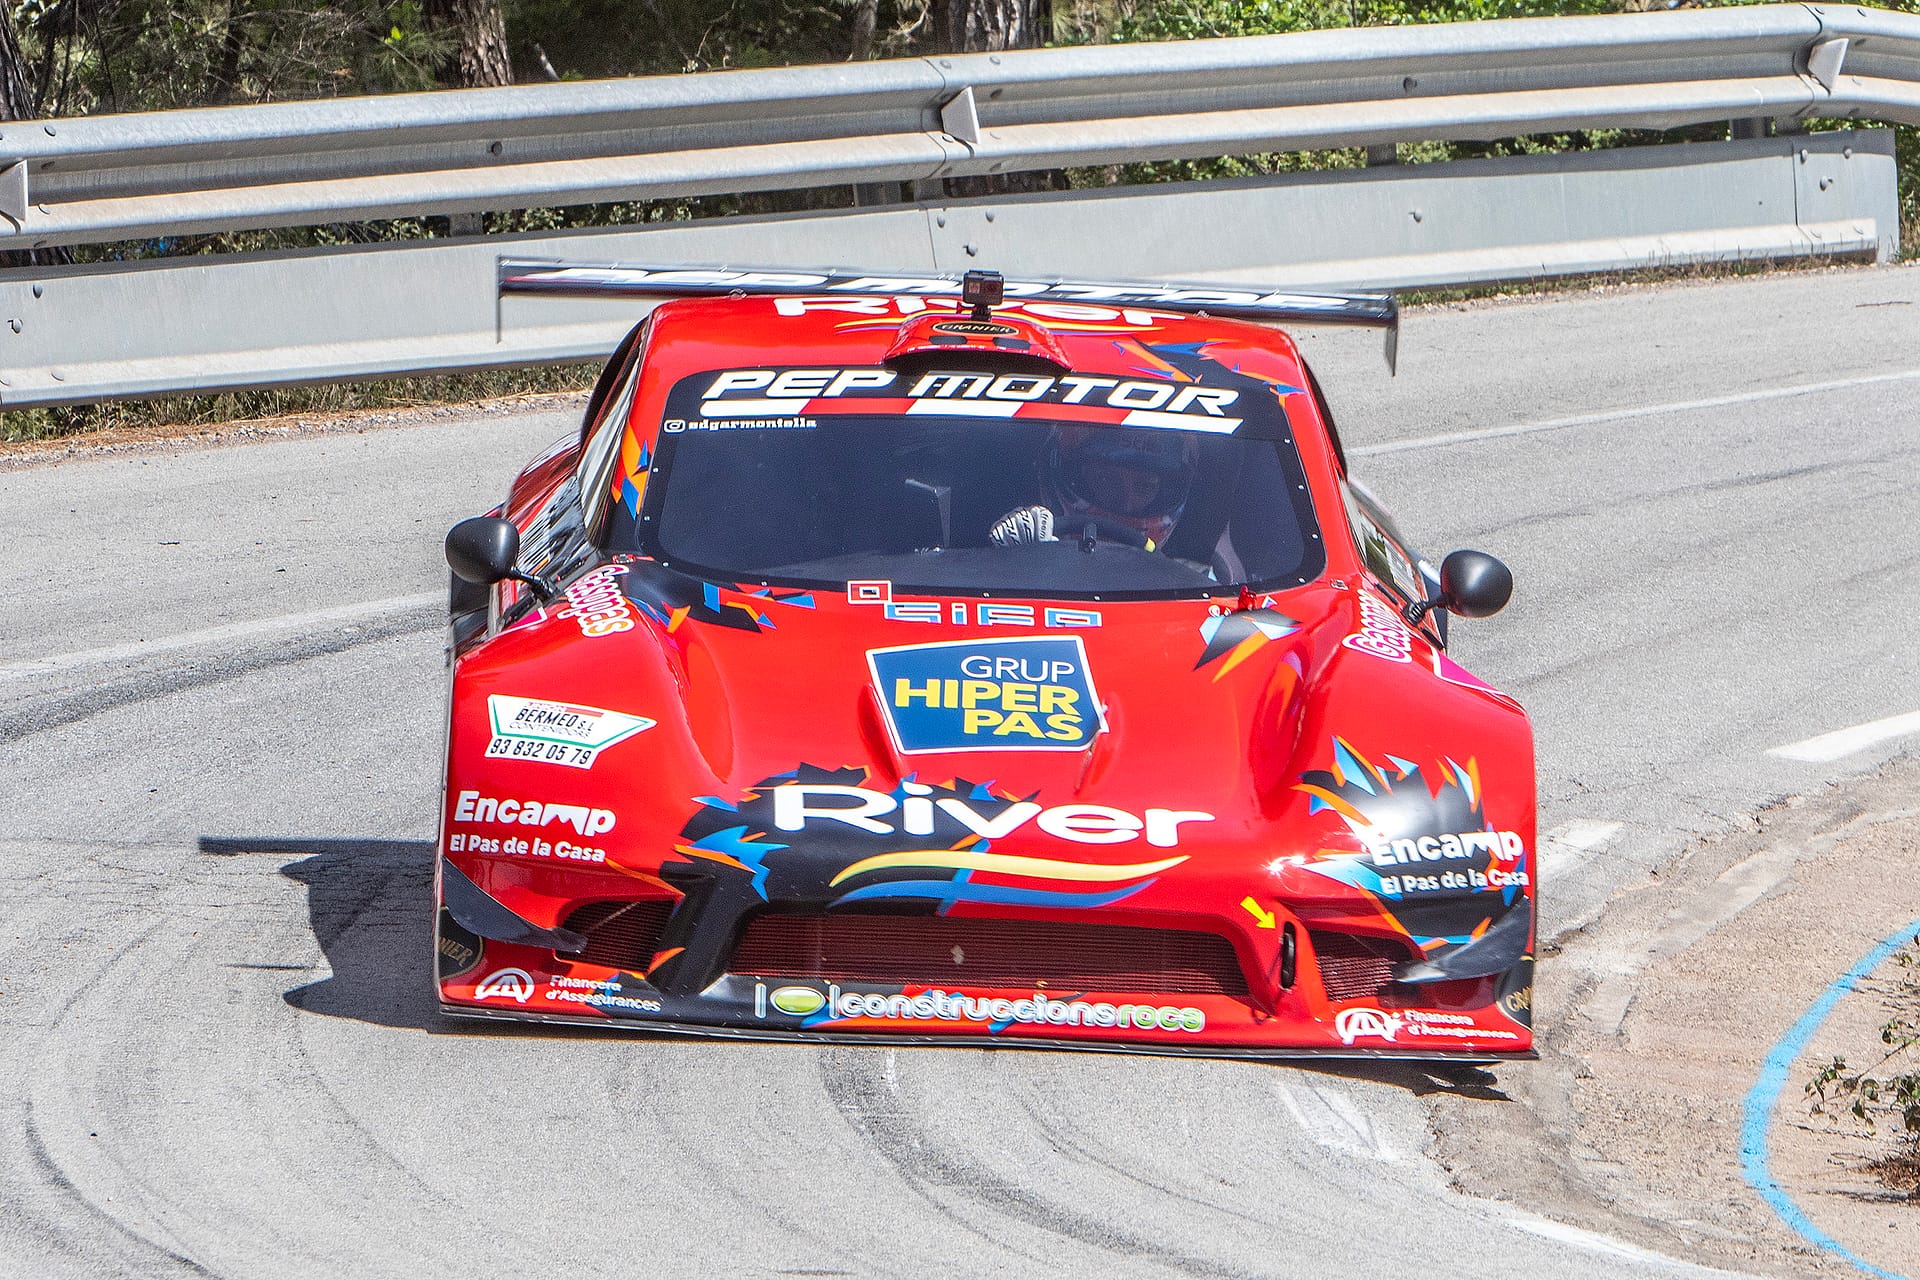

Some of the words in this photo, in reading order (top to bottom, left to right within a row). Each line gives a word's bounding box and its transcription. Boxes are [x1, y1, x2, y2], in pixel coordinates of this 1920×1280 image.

[701, 370, 898, 400] PEP
[907, 370, 1240, 416] MOTOR
[961, 656, 1075, 682] GRUP
[895, 679, 1081, 716] HIPER
[964, 709, 1084, 741] PAS
[490, 739, 511, 754] 93
[513, 740, 544, 758] 832
[546, 744, 568, 761] 05
[570, 749, 592, 765] 79
[454, 790, 617, 837] Encamp
[774, 782, 1216, 847] River
[450, 833, 466, 852] El
[468, 834, 500, 854] Pas
[503, 837, 529, 855] de
[531, 837, 552, 856] la
[554, 841, 606, 862] Casa
[1370, 831, 1524, 867] Encamp
[1381, 875, 1400, 895] El
[1402, 874, 1440, 893] Pas
[1441, 871, 1468, 889] de
[1467, 868, 1488, 887] la
[1488, 868, 1530, 887] Casa
[550, 974, 622, 992] Financera
[545, 990, 662, 1012] d'Assegurances
